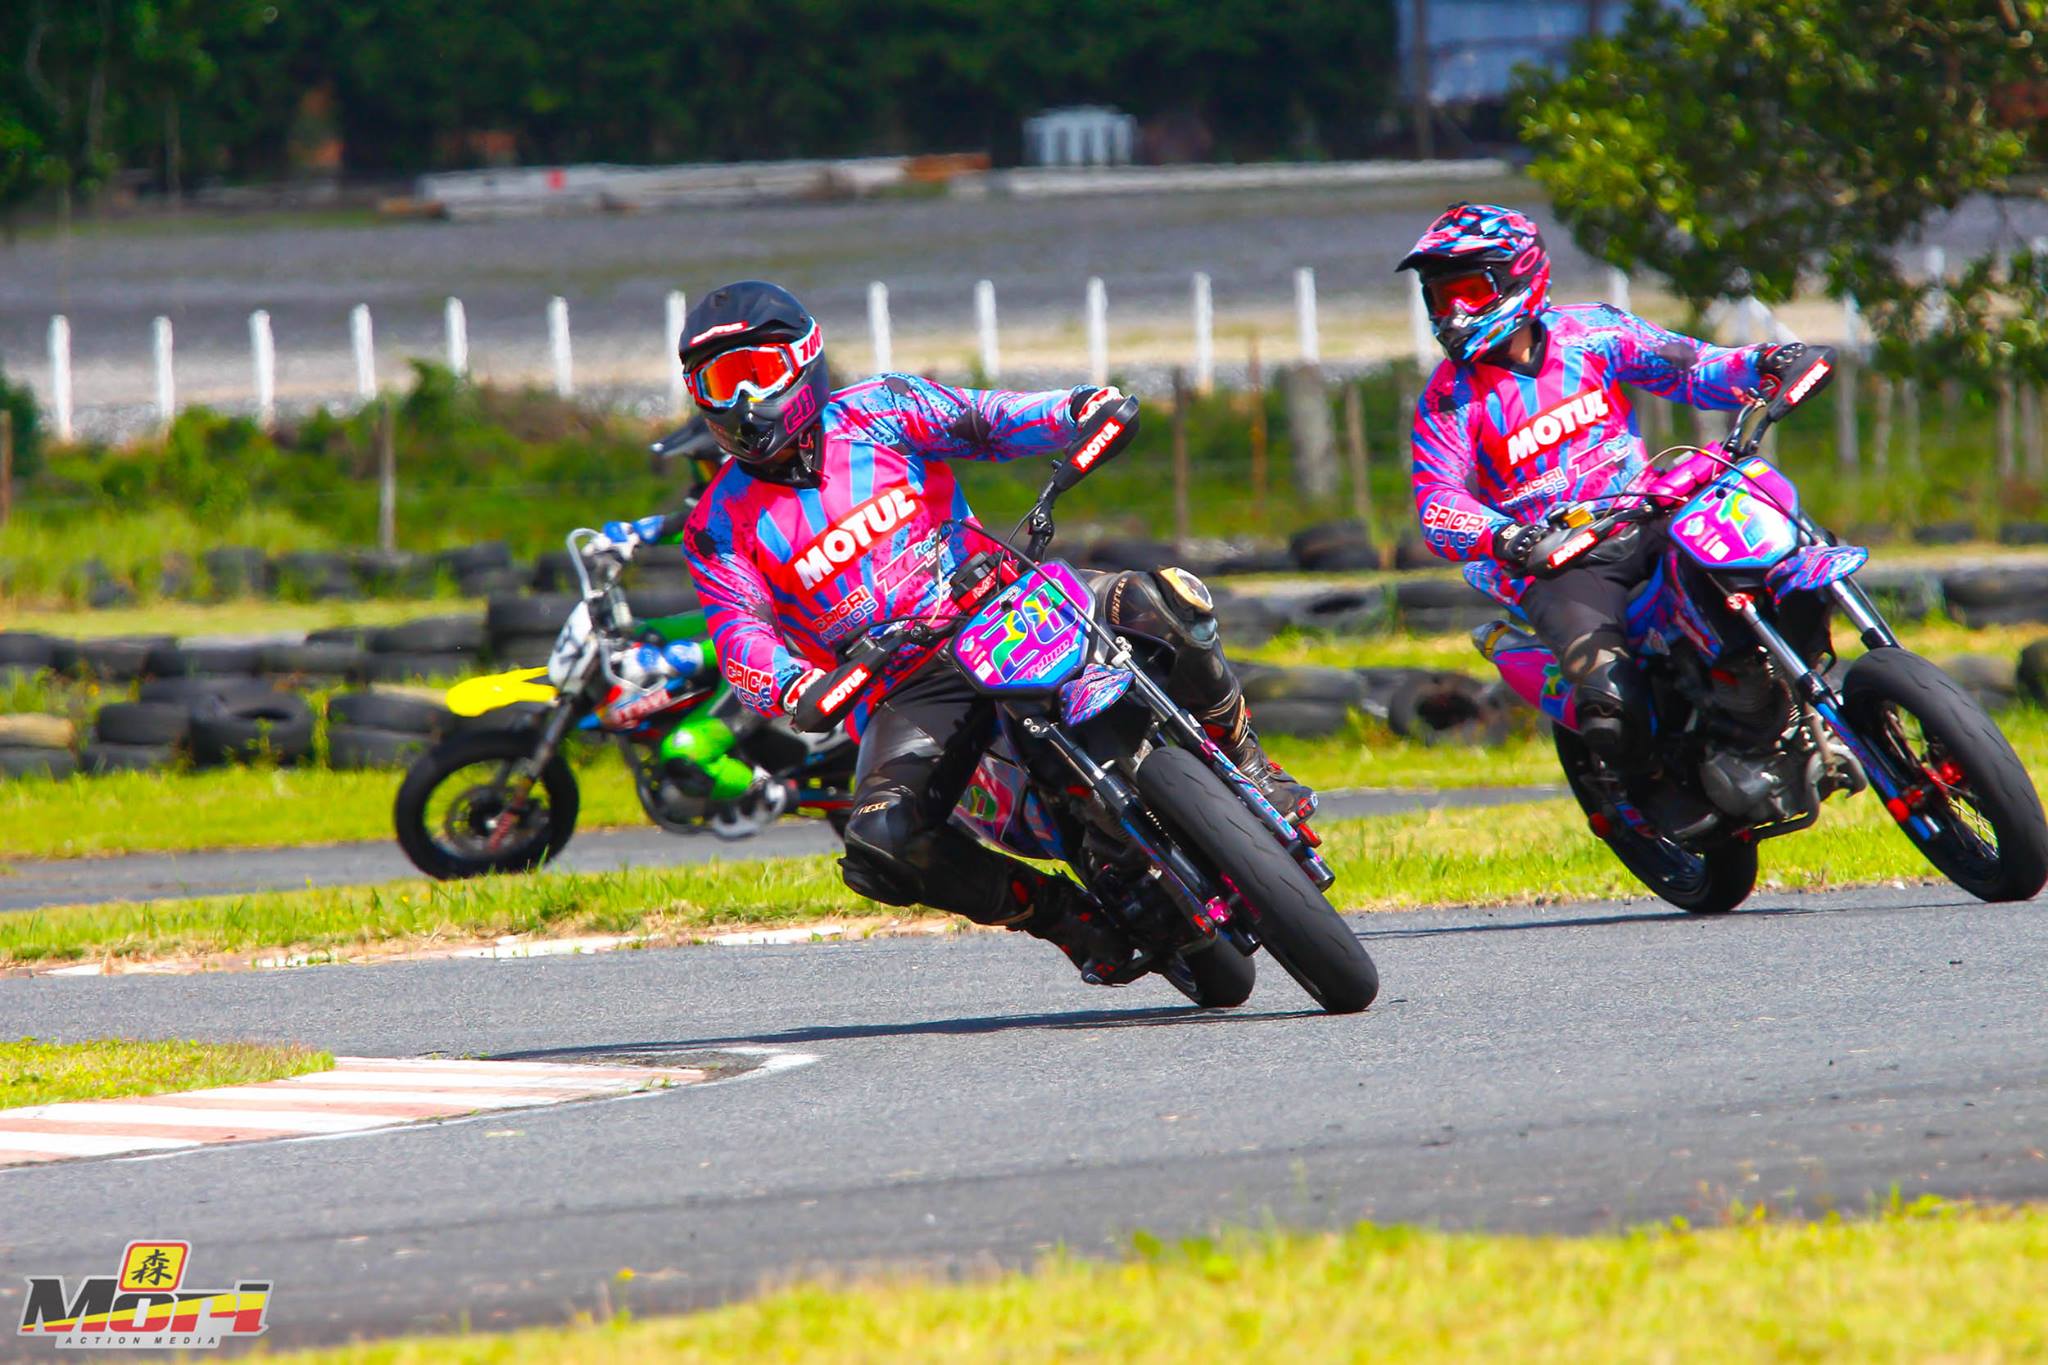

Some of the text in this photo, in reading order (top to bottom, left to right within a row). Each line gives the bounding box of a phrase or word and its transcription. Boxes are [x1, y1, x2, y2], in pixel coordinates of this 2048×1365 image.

[1790, 363, 1829, 403] MOTUL
[779, 384, 816, 434] 28
[1508, 389, 1608, 465] MOTUL
[1076, 422, 1120, 468] MOTUL
[794, 489, 916, 591] MOTUL
[814, 586, 870, 631] CRICRI
[821, 600, 877, 640] MOTOS
[979, 578, 1078, 683] 28
[822, 668, 867, 712] MOTUL
